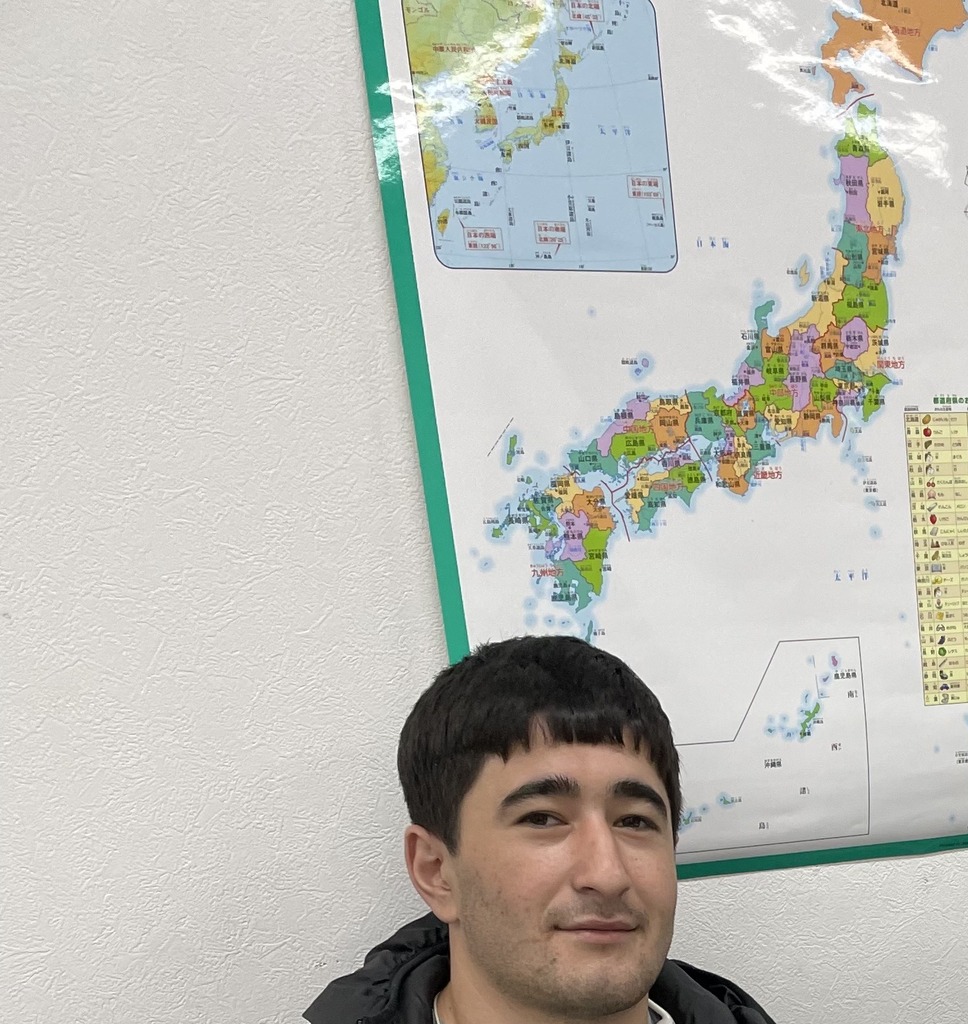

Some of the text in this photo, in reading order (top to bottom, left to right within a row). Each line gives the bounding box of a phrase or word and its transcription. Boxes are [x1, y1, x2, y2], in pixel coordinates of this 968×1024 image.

[558, 57, 577, 65] 北海道
[551, 109, 564, 117] 日本
[846, 179, 863, 187] 秋田県
[741, 332, 759, 340] 石川県
[877, 360, 905, 369] 関東地方
[790, 375, 807, 383] 長野県
[774, 417, 792, 425] 愛知県
[625, 439, 645, 447] 広島県
[578, 455, 598, 463] 山口県
[753, 471, 782, 480] 近畿地方
[531, 568, 564, 577] 九州地方
